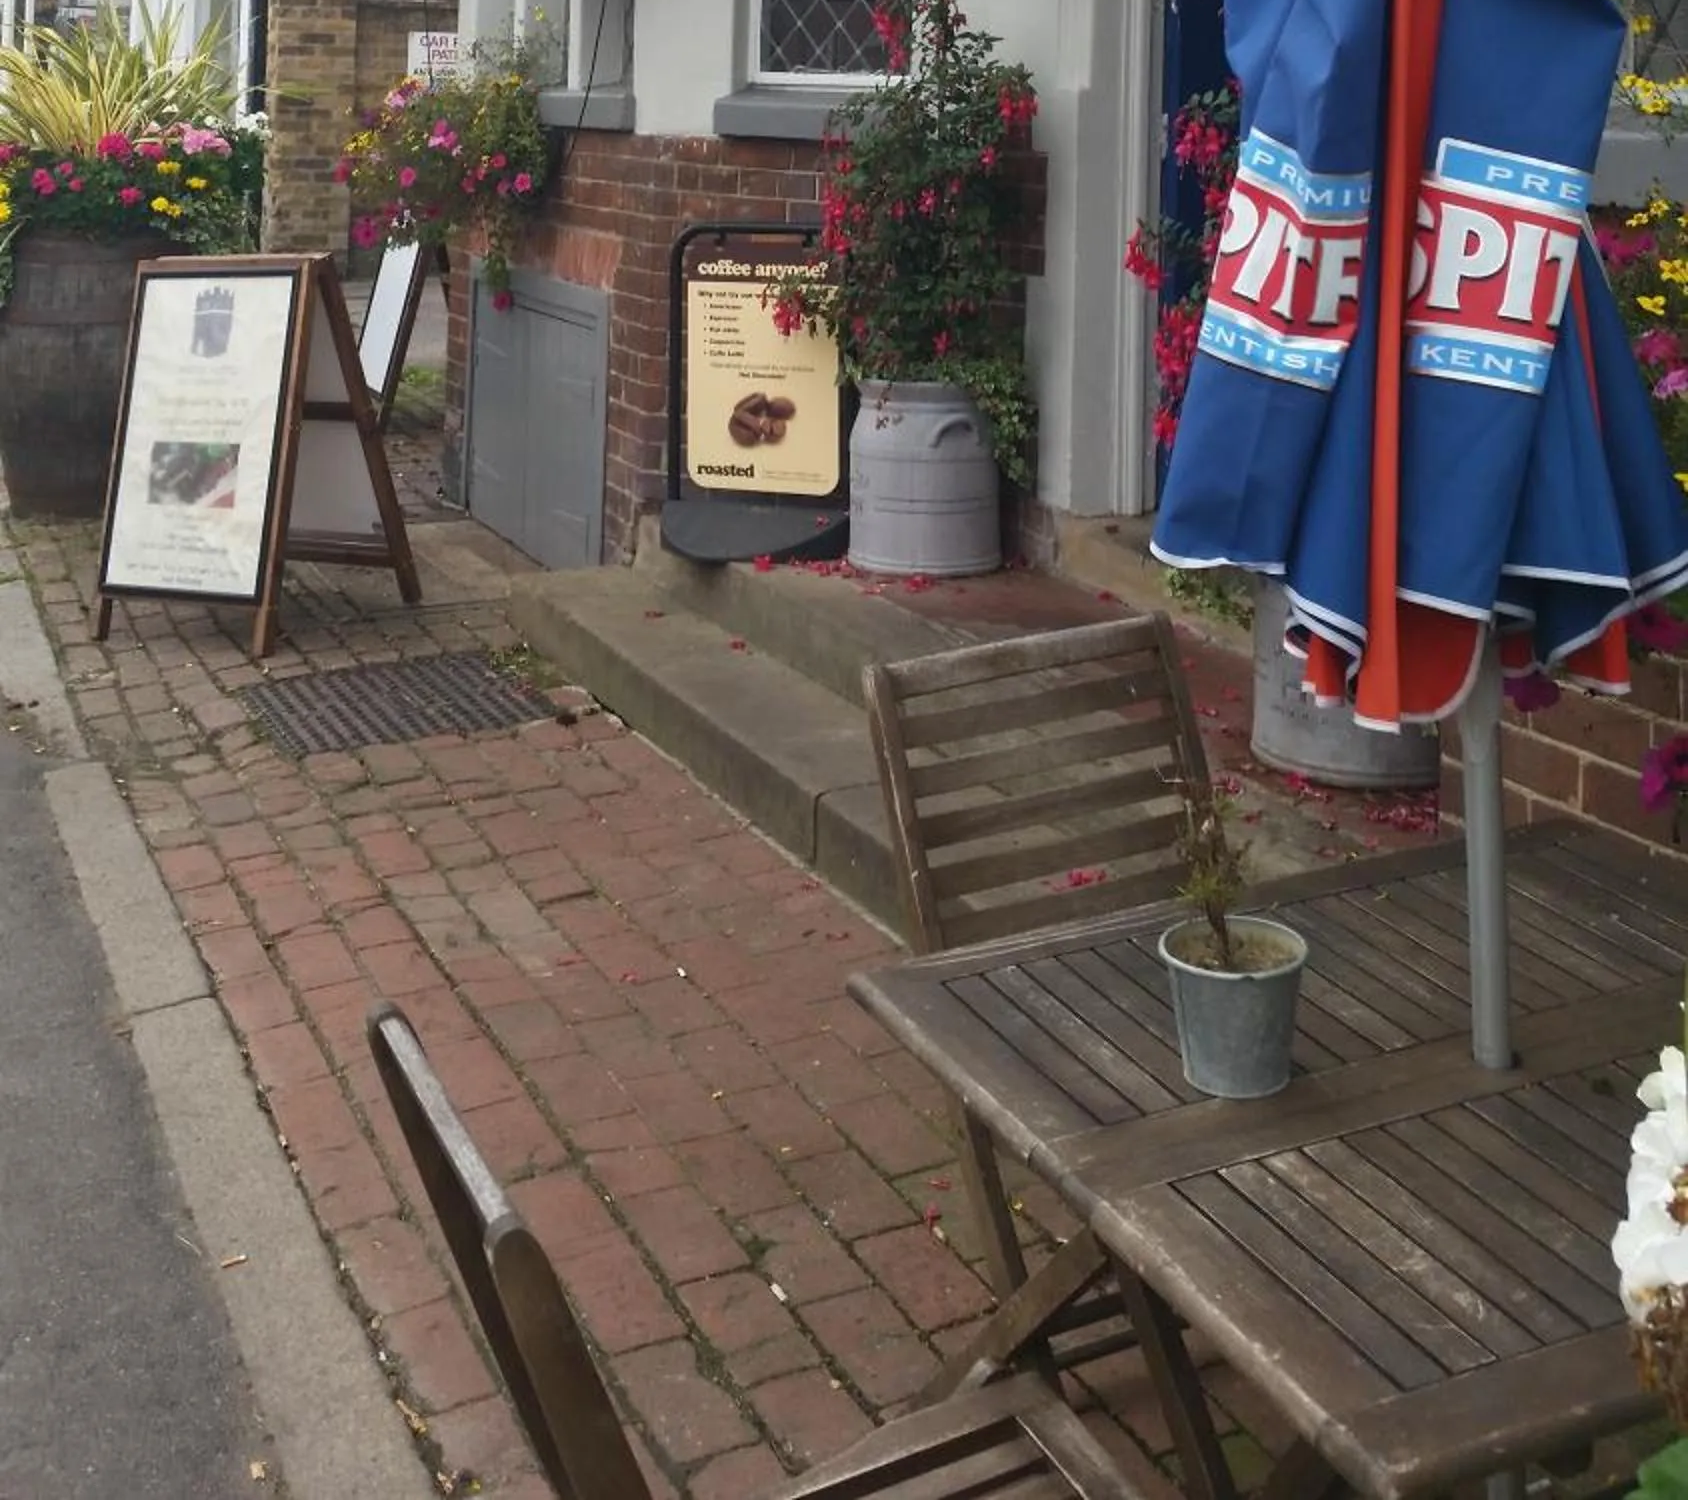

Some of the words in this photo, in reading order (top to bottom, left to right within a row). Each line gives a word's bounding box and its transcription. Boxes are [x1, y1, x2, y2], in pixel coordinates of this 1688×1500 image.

[419, 35, 448, 48] CAR
[1486, 165, 1585, 203] PRE
[697, 260, 751, 275] coffee
[755, 261, 829, 281] anyone?
[1420, 343, 1545, 380] KENT
[697, 463, 755, 478] roasted
